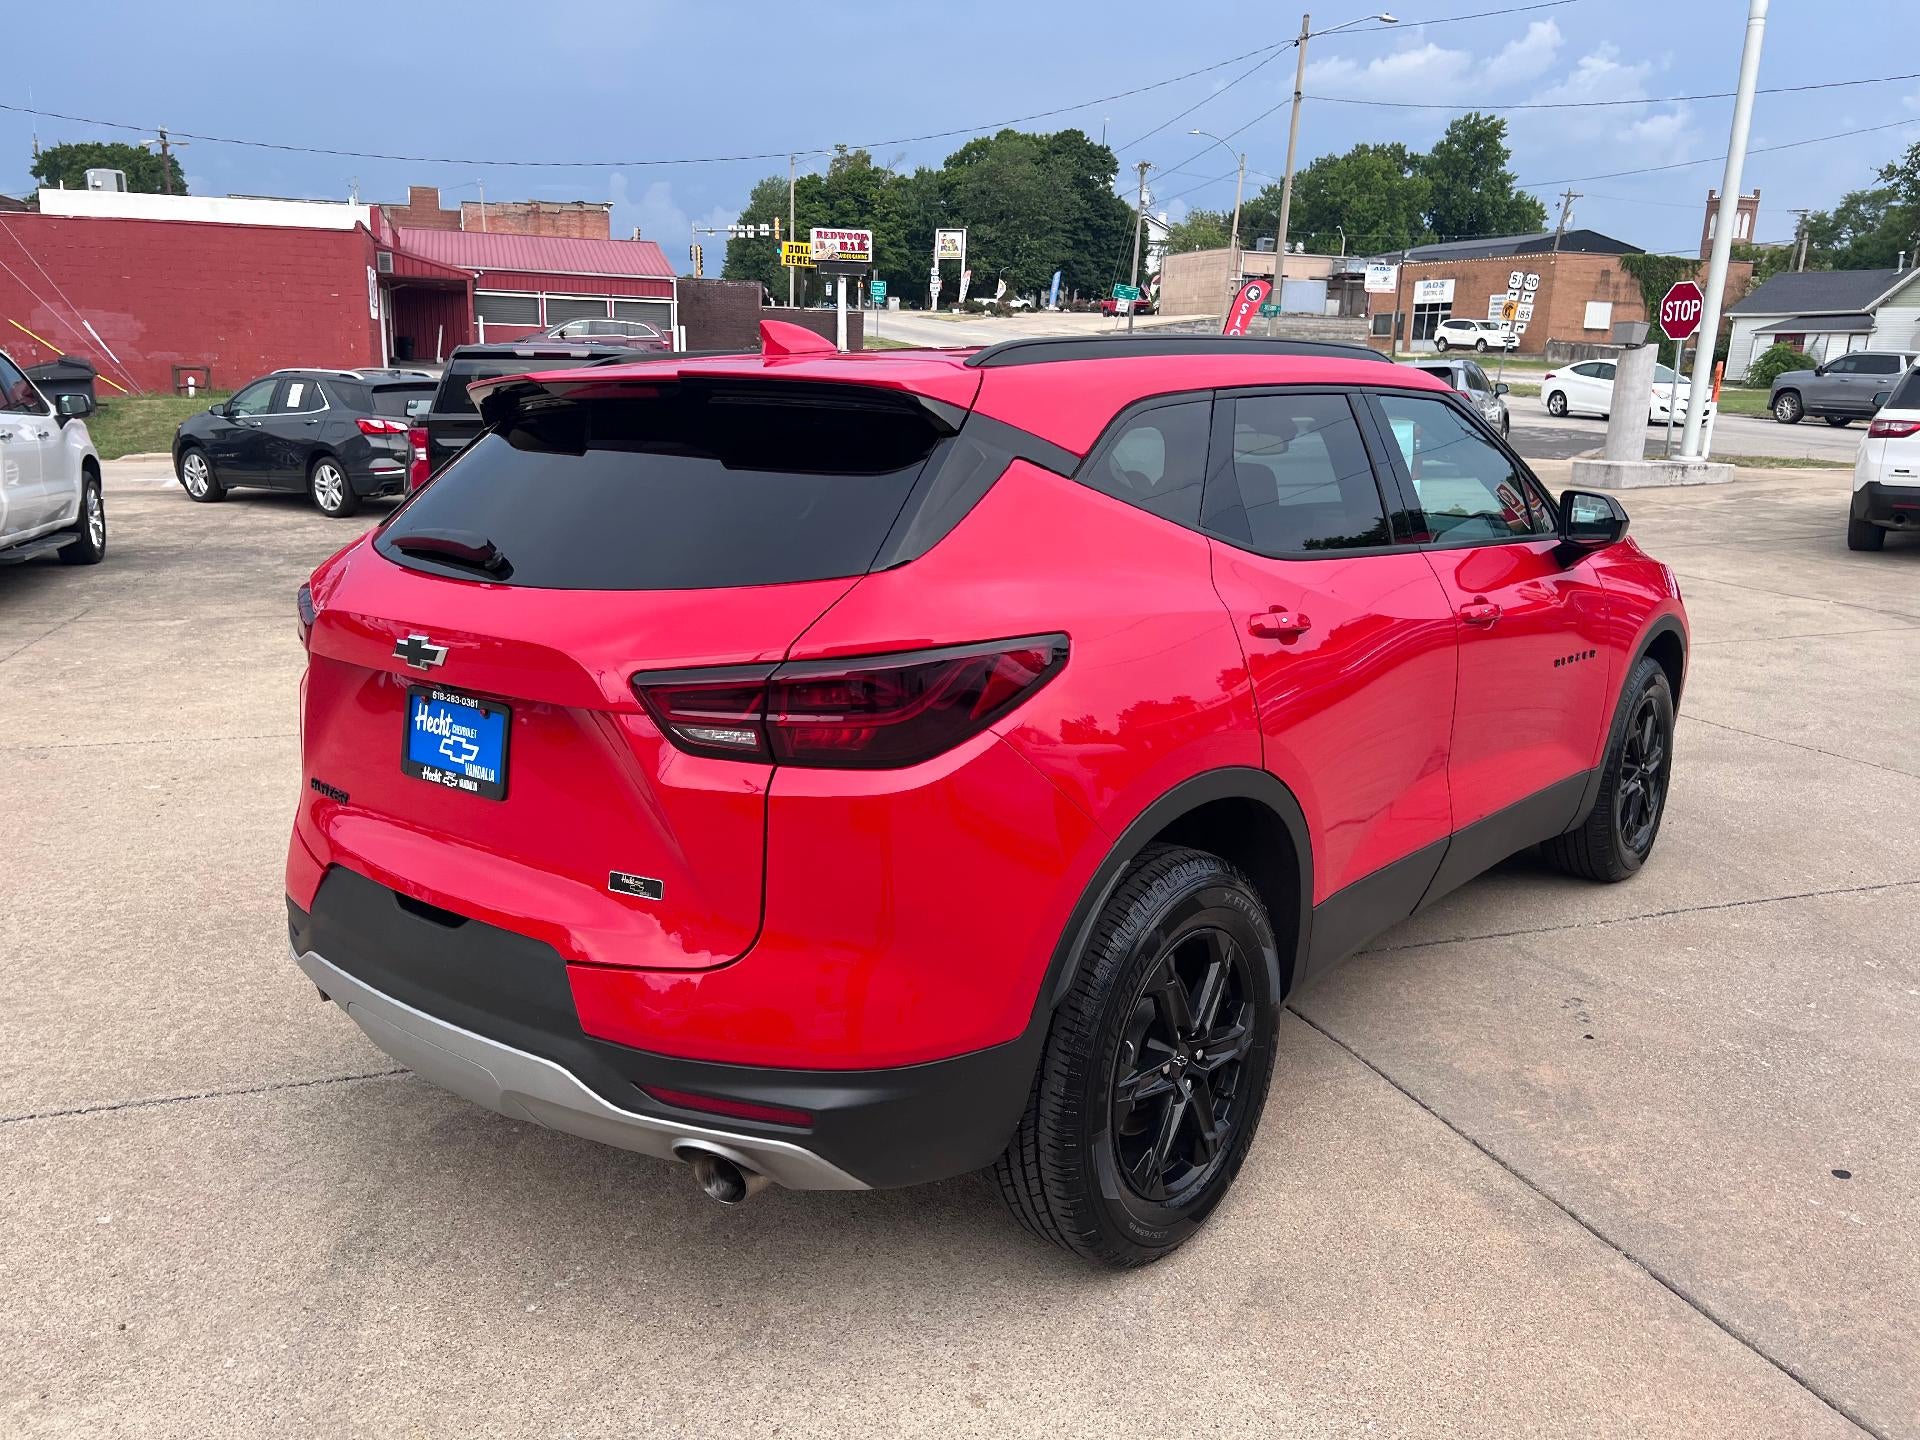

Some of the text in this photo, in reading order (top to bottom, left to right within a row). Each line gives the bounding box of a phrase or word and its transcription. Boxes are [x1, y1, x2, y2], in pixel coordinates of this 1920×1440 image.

[788, 244, 811, 255] DOLL
[839, 241, 869, 252] BAR
[1424, 280, 1445, 289] ADS
[1510, 274, 1522, 285] 51
[1525, 277, 1538, 288] 40
[1517, 309, 1531, 320] 185
[1663, 299, 1701, 322] STOP
[432, 690, 479, 709] 618-263-0381
[414, 702, 454, 738] Hecht
[451, 723, 478, 739] CHEVROLET
[421, 765, 443, 784] Hecht
[464, 762, 495, 783] VANDALIA
